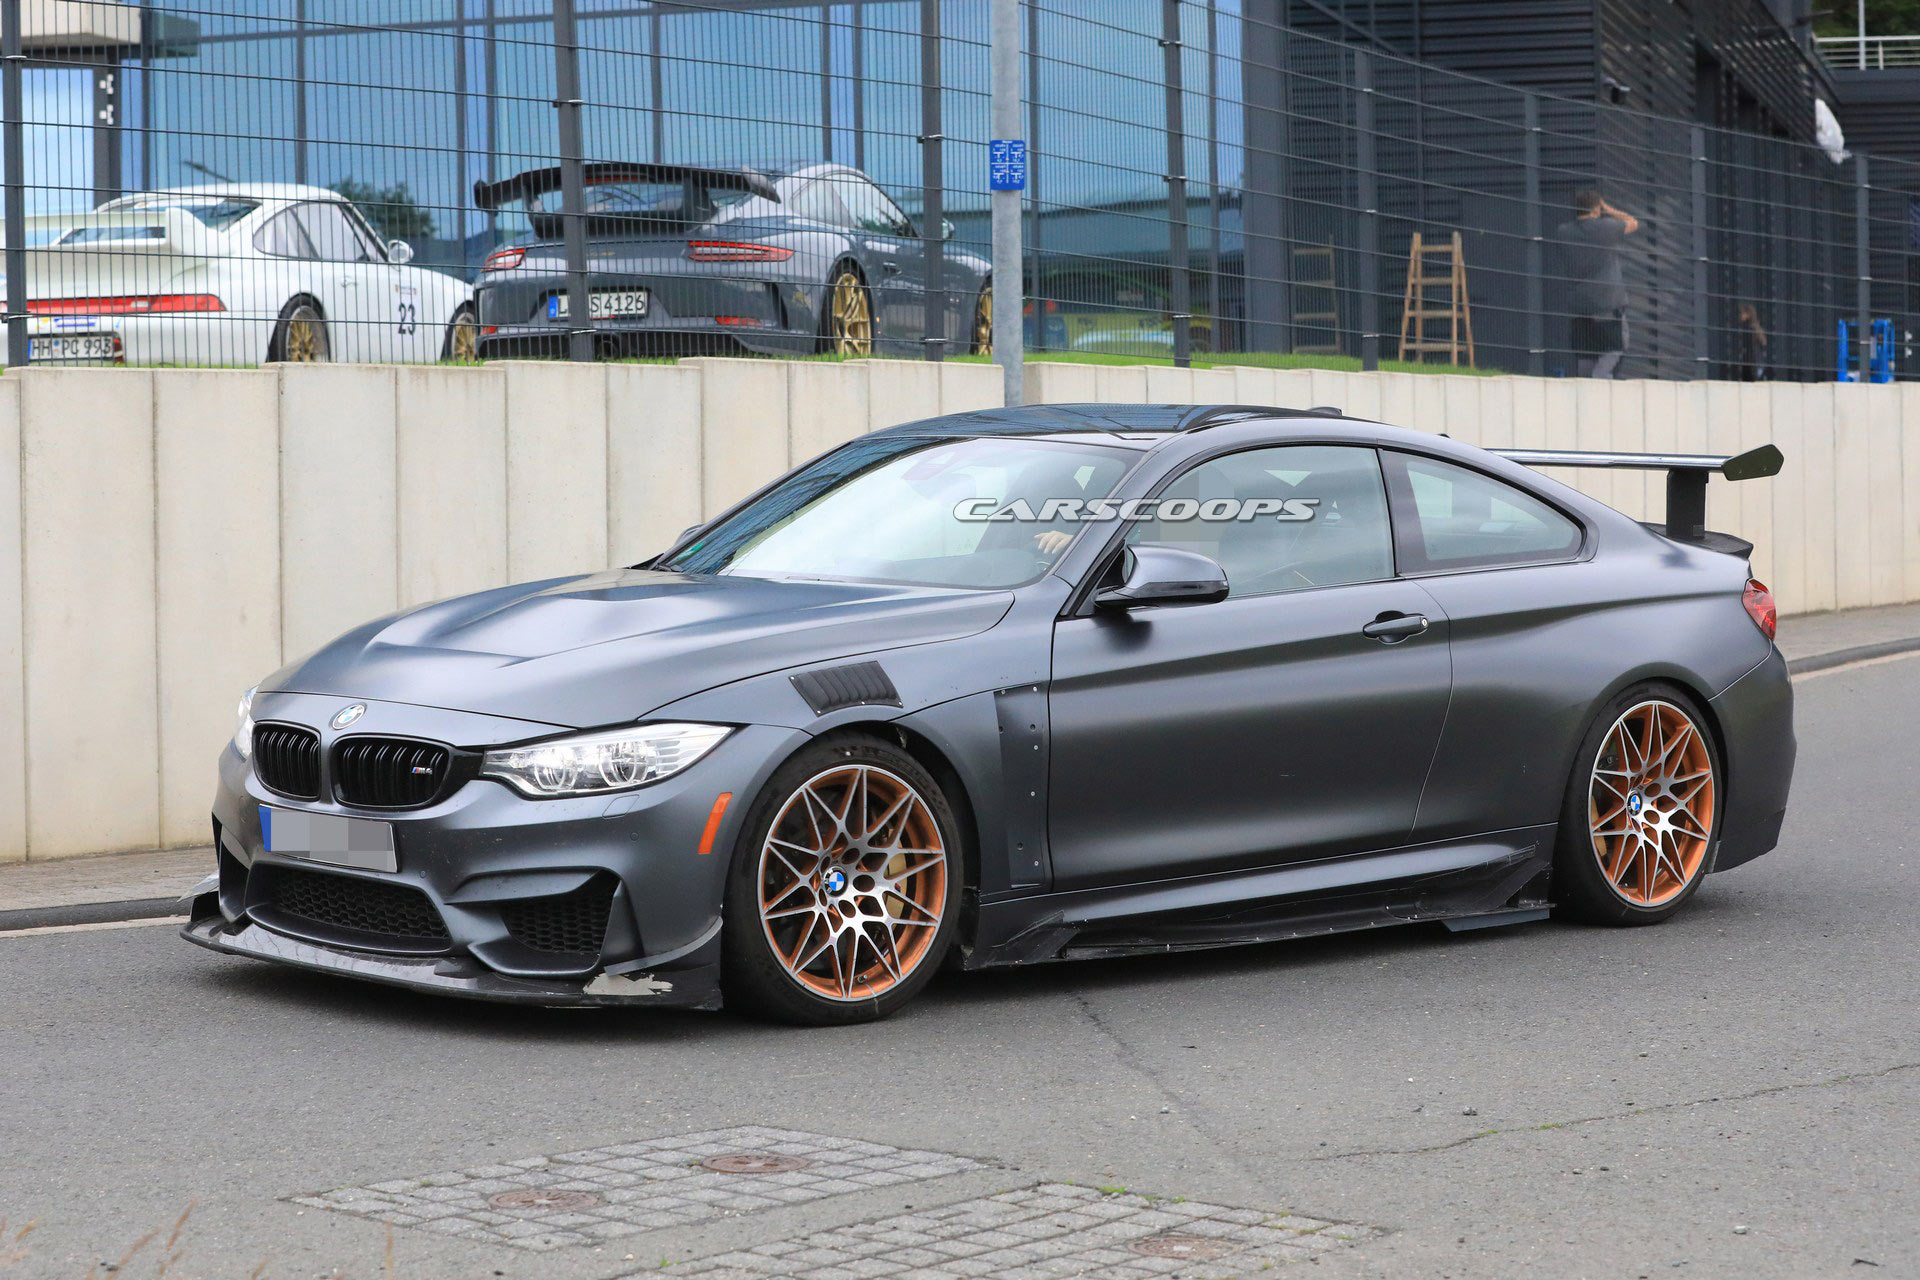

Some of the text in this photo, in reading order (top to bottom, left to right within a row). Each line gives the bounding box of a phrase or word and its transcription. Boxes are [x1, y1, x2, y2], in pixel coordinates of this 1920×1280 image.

[604, 294, 645, 312] 4126
[398, 302, 416, 336] 23
[31, 340, 52, 356] HH
[83, 338, 112, 355] 993
